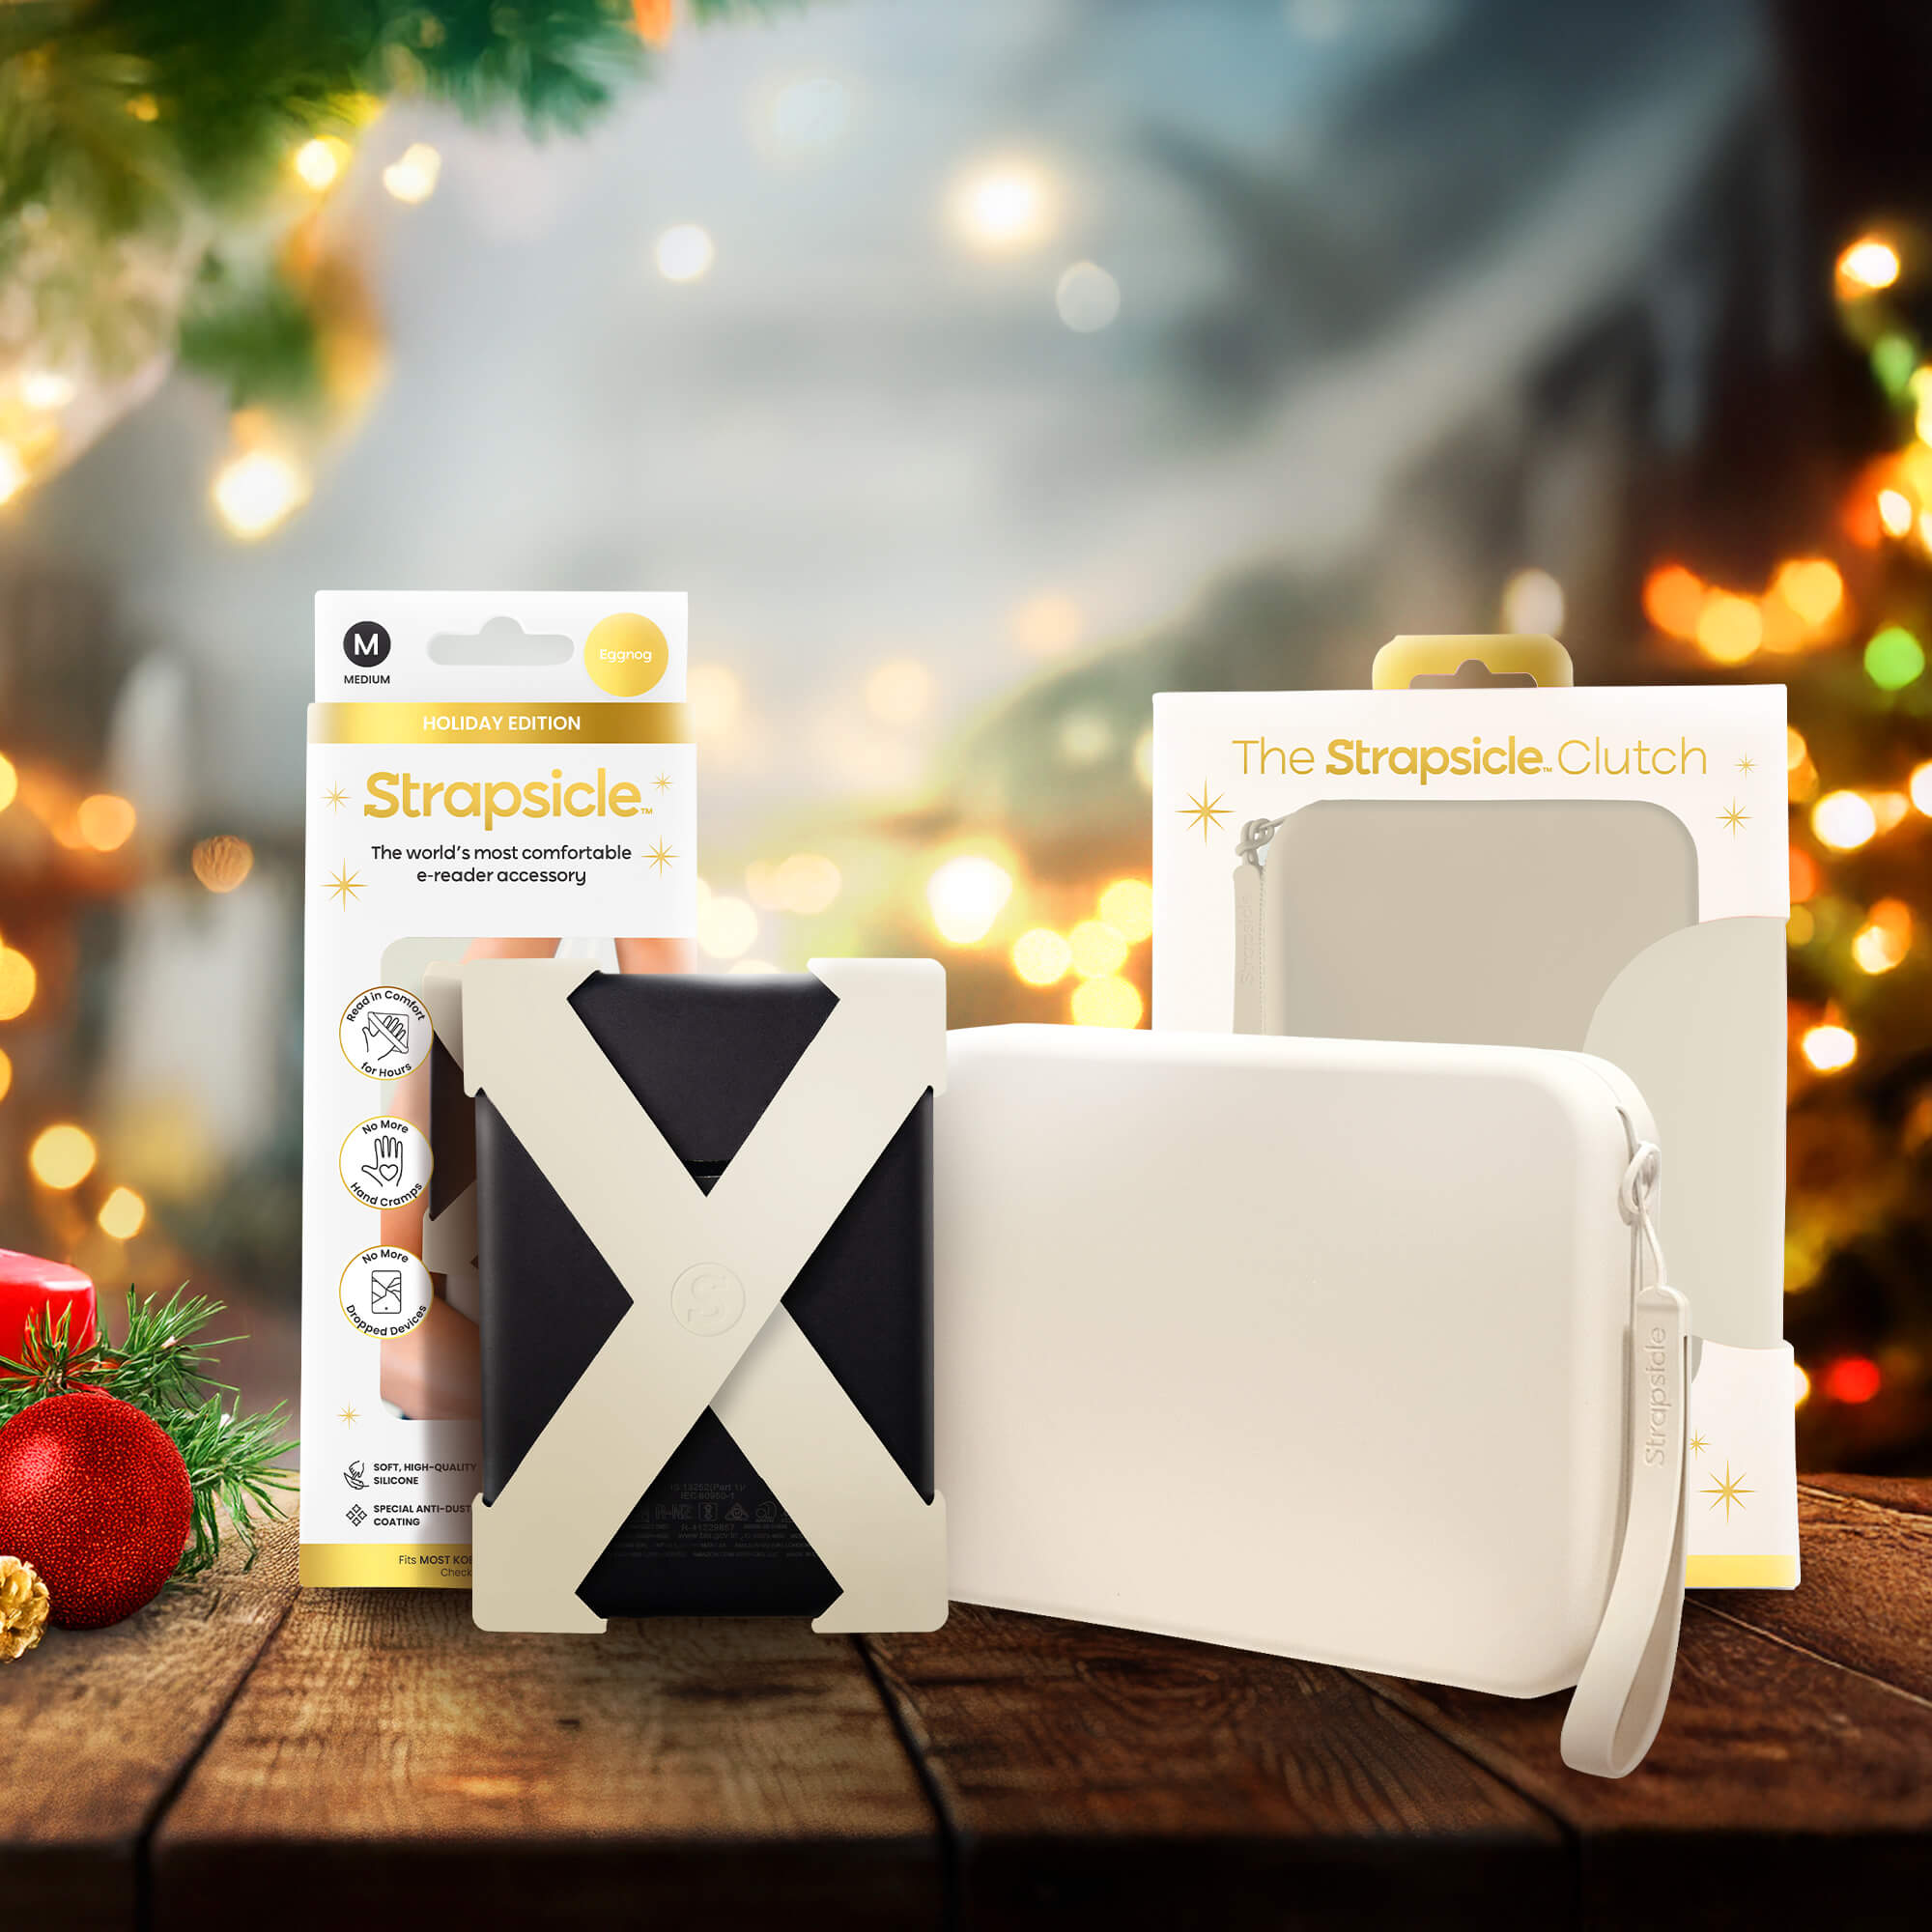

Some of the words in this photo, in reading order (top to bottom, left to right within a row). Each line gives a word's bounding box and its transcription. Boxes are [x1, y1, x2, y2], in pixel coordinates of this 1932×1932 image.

[354, 633, 379, 656] M
[599, 647, 652, 664] Eggnog
[343, 674, 390, 685] MEDIUM
[422, 716, 502, 731] HOLIDAY
[508, 716, 581, 731] EDITION
[1232, 736, 1315, 776] The
[1557, 736, 1708, 776] Clutch
[371, 845, 403, 860] The
[474, 846, 519, 860] most
[522, 845, 632, 860] comfortable
[416, 867, 494, 883] e-reader
[497, 870, 586, 886] accessory
[346, 996, 370, 1022] Read
[370, 991, 383, 1002] in
[384, 990, 426, 1021] Comfort
[360, 1062, 378, 1075] for
[379, 1063, 412, 1078] Hours
[361, 1122, 378, 1135] No
[381, 1120, 409, 1133] More
[350, 1181, 379, 1206] Hand
[380, 1182, 422, 1207] Cramps
[361, 1252, 378, 1264] No
[381, 1249, 409, 1263] More
[346, 1304, 387, 1336] Dropped
[389, 1305, 427, 1336] Devices
[1645, 1326, 1672, 1467] Strapsicle
[373, 1463, 402, 1473] SOFT,
[404, 1463, 477, 1473] HIGH-QUALITY
[373, 1476, 419, 1485] SILICONE
[373, 1504, 413, 1514] SPECIAL
[415, 1504, 471, 1514] ANTI-DUST
[373, 1518, 420, 1526] COATING
[398, 1554, 417, 1565] Fits
[419, 1555, 450, 1565] MOST
[440, 1568, 472, 1577] Check
